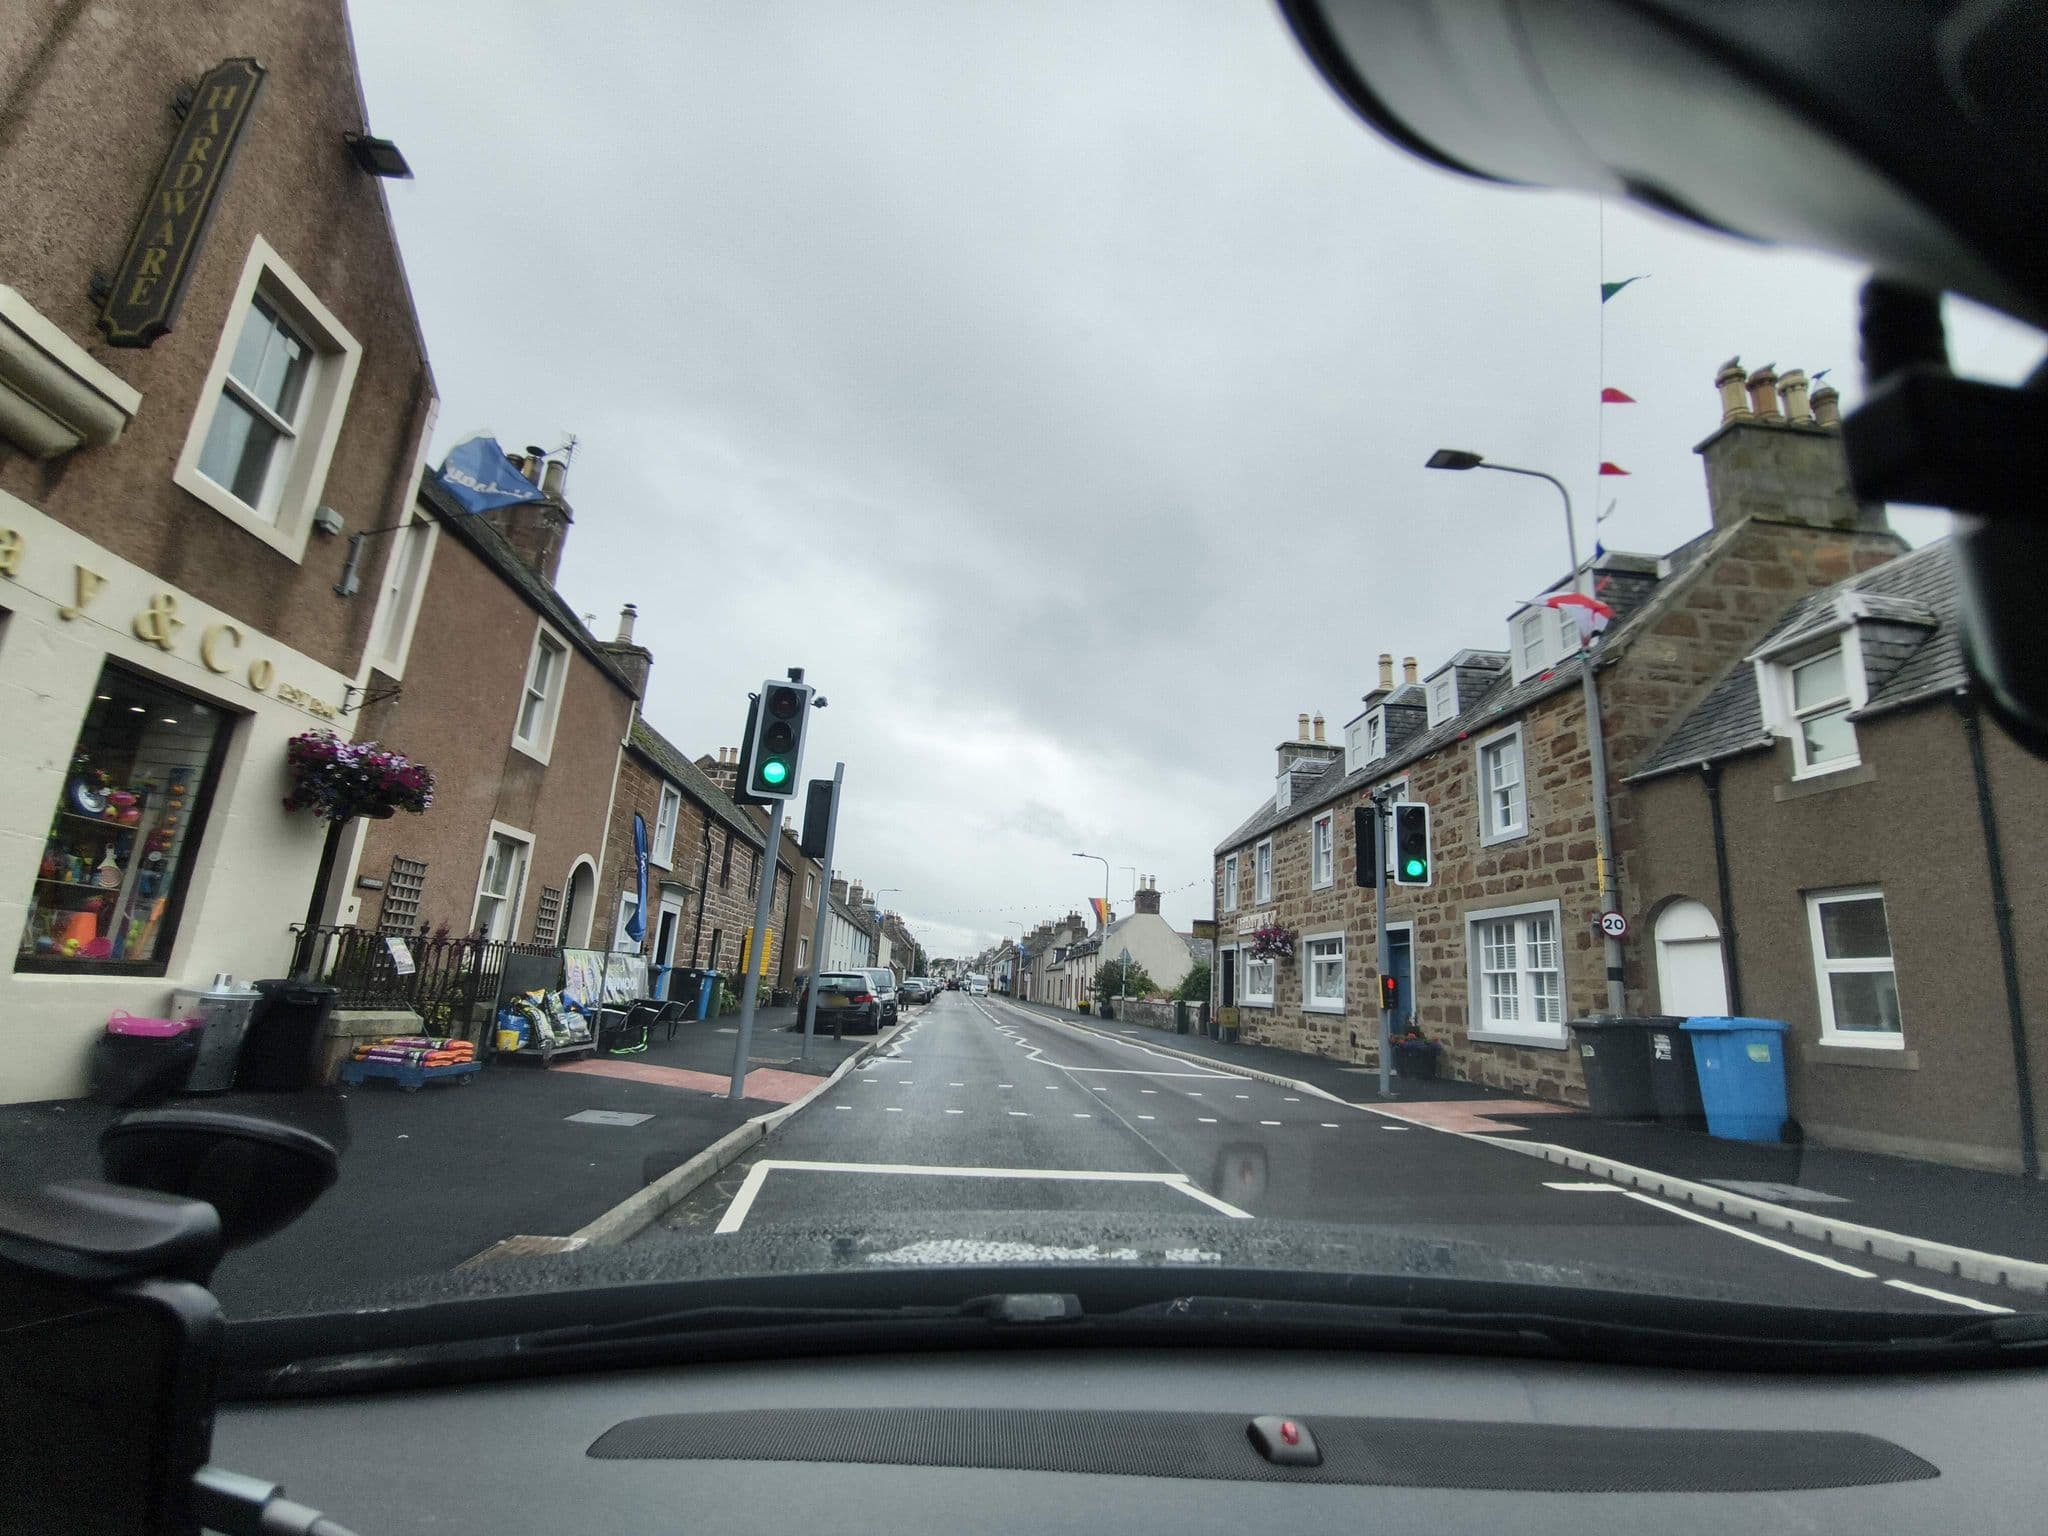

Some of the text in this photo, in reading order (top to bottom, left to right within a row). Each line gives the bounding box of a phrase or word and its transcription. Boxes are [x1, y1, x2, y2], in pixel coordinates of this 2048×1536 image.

[127, 86, 238, 306] HARDWARE
[132, 592, 185, 652] &
[200, 624, 274, 692] Co
[1604, 919, 1624, 930] 20
